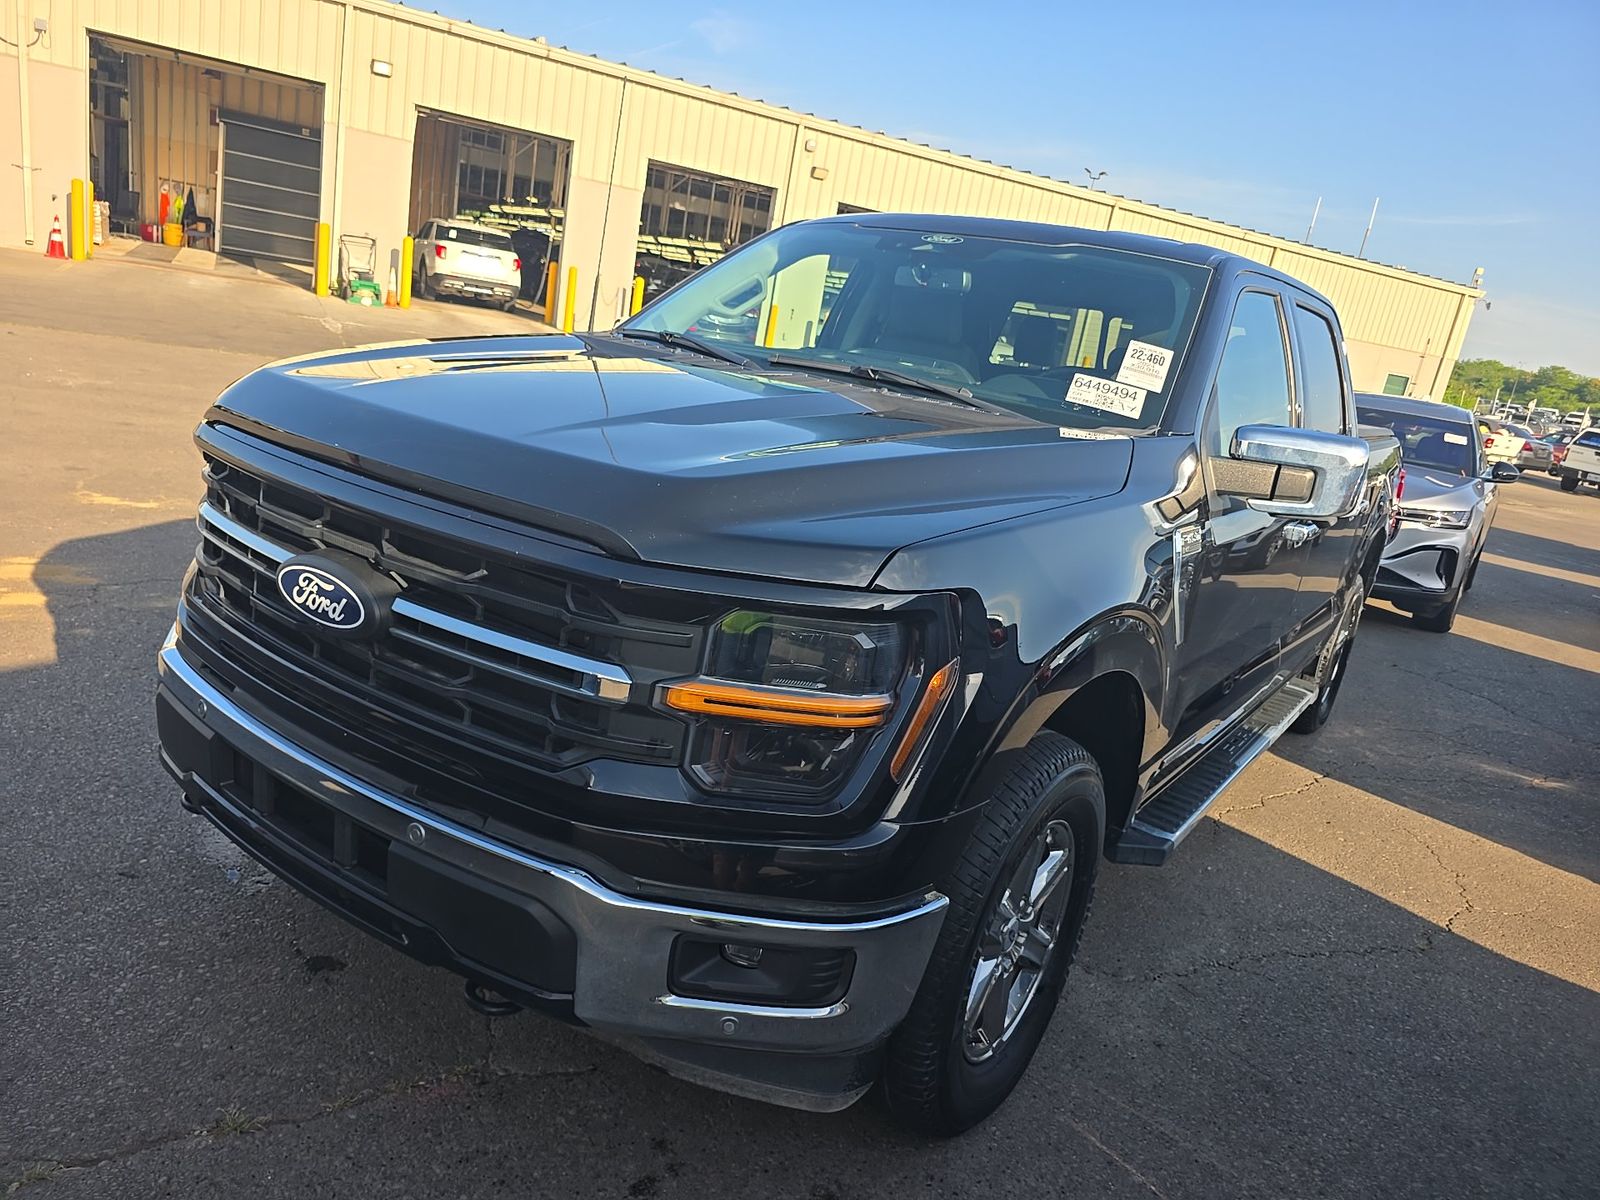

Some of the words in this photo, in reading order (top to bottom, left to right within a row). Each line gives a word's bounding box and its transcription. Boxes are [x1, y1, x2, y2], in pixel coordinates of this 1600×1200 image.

[1130, 348, 1166, 366] 22:460
[1074, 377, 1138, 401] 6449494
[292, 572, 348, 622] Ford
